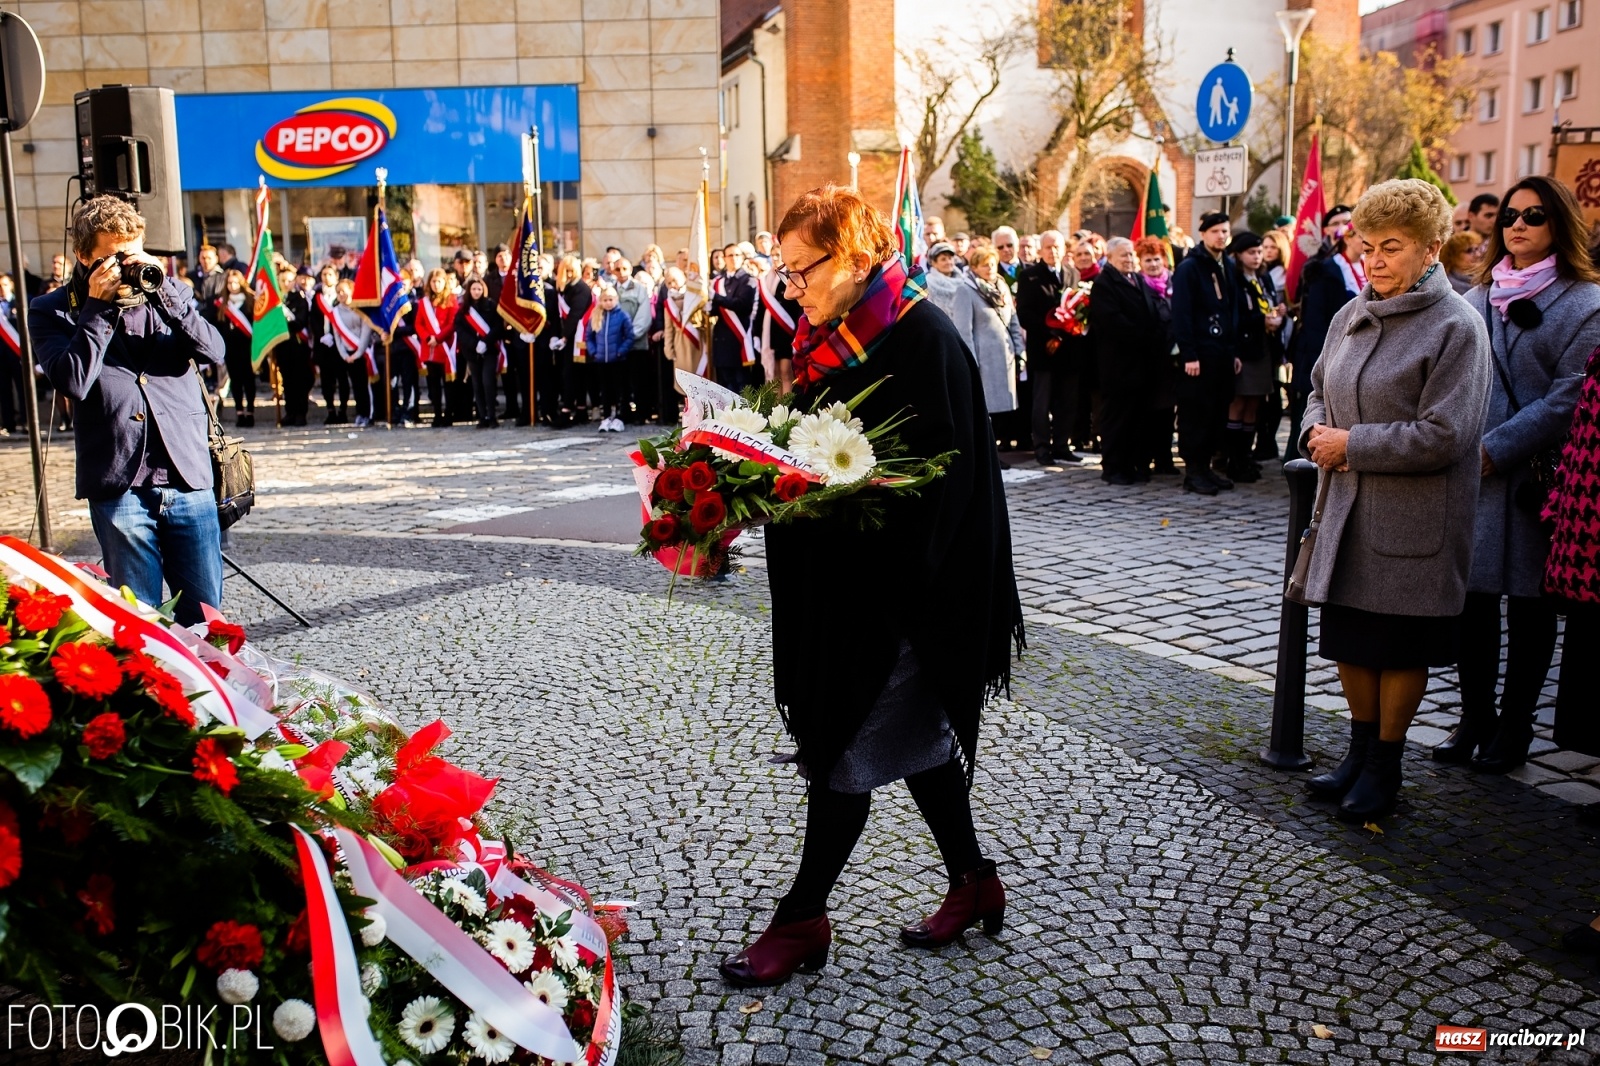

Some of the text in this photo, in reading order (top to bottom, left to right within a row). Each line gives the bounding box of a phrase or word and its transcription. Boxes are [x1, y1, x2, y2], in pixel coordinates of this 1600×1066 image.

[277, 125, 374, 153] PEPCO
[1198, 151, 1242, 164] Nie dotyczy
